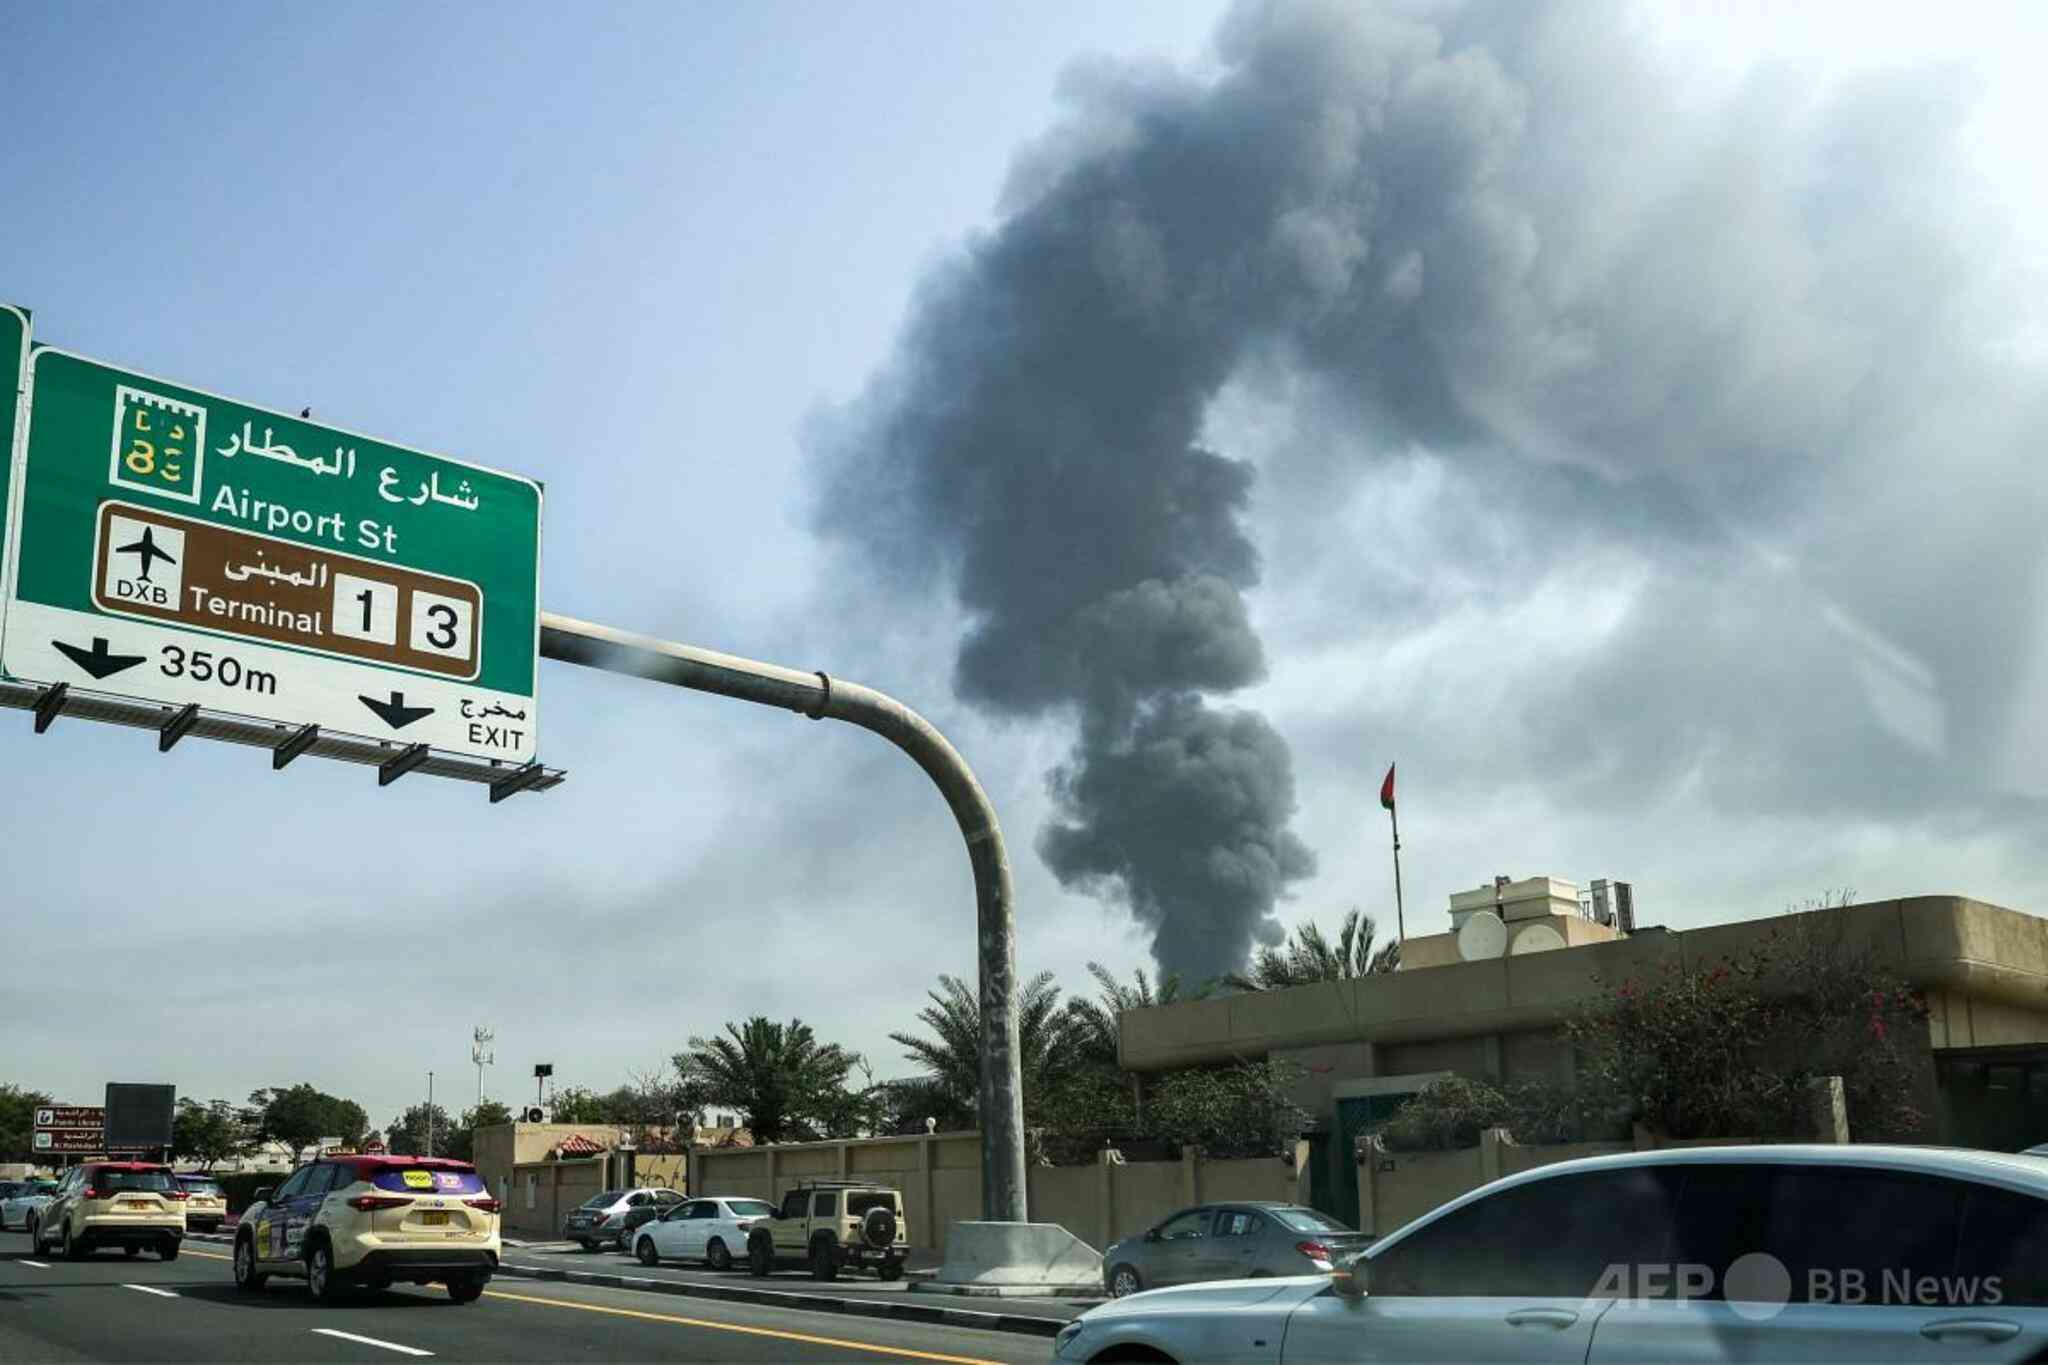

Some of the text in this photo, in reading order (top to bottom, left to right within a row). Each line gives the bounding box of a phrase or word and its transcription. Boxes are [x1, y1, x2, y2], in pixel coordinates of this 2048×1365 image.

[216, 421, 480, 511] شارع المطار
[211, 485, 398, 554] Airport St
[224, 550, 328, 588] المبنى
[117, 580, 168, 604] DXB
[189, 586, 458, 649] Terminal 1 3
[160, 645, 276, 695] 350m
[460, 699, 527, 721] مخرج
[469, 723, 524, 750] EXIT
